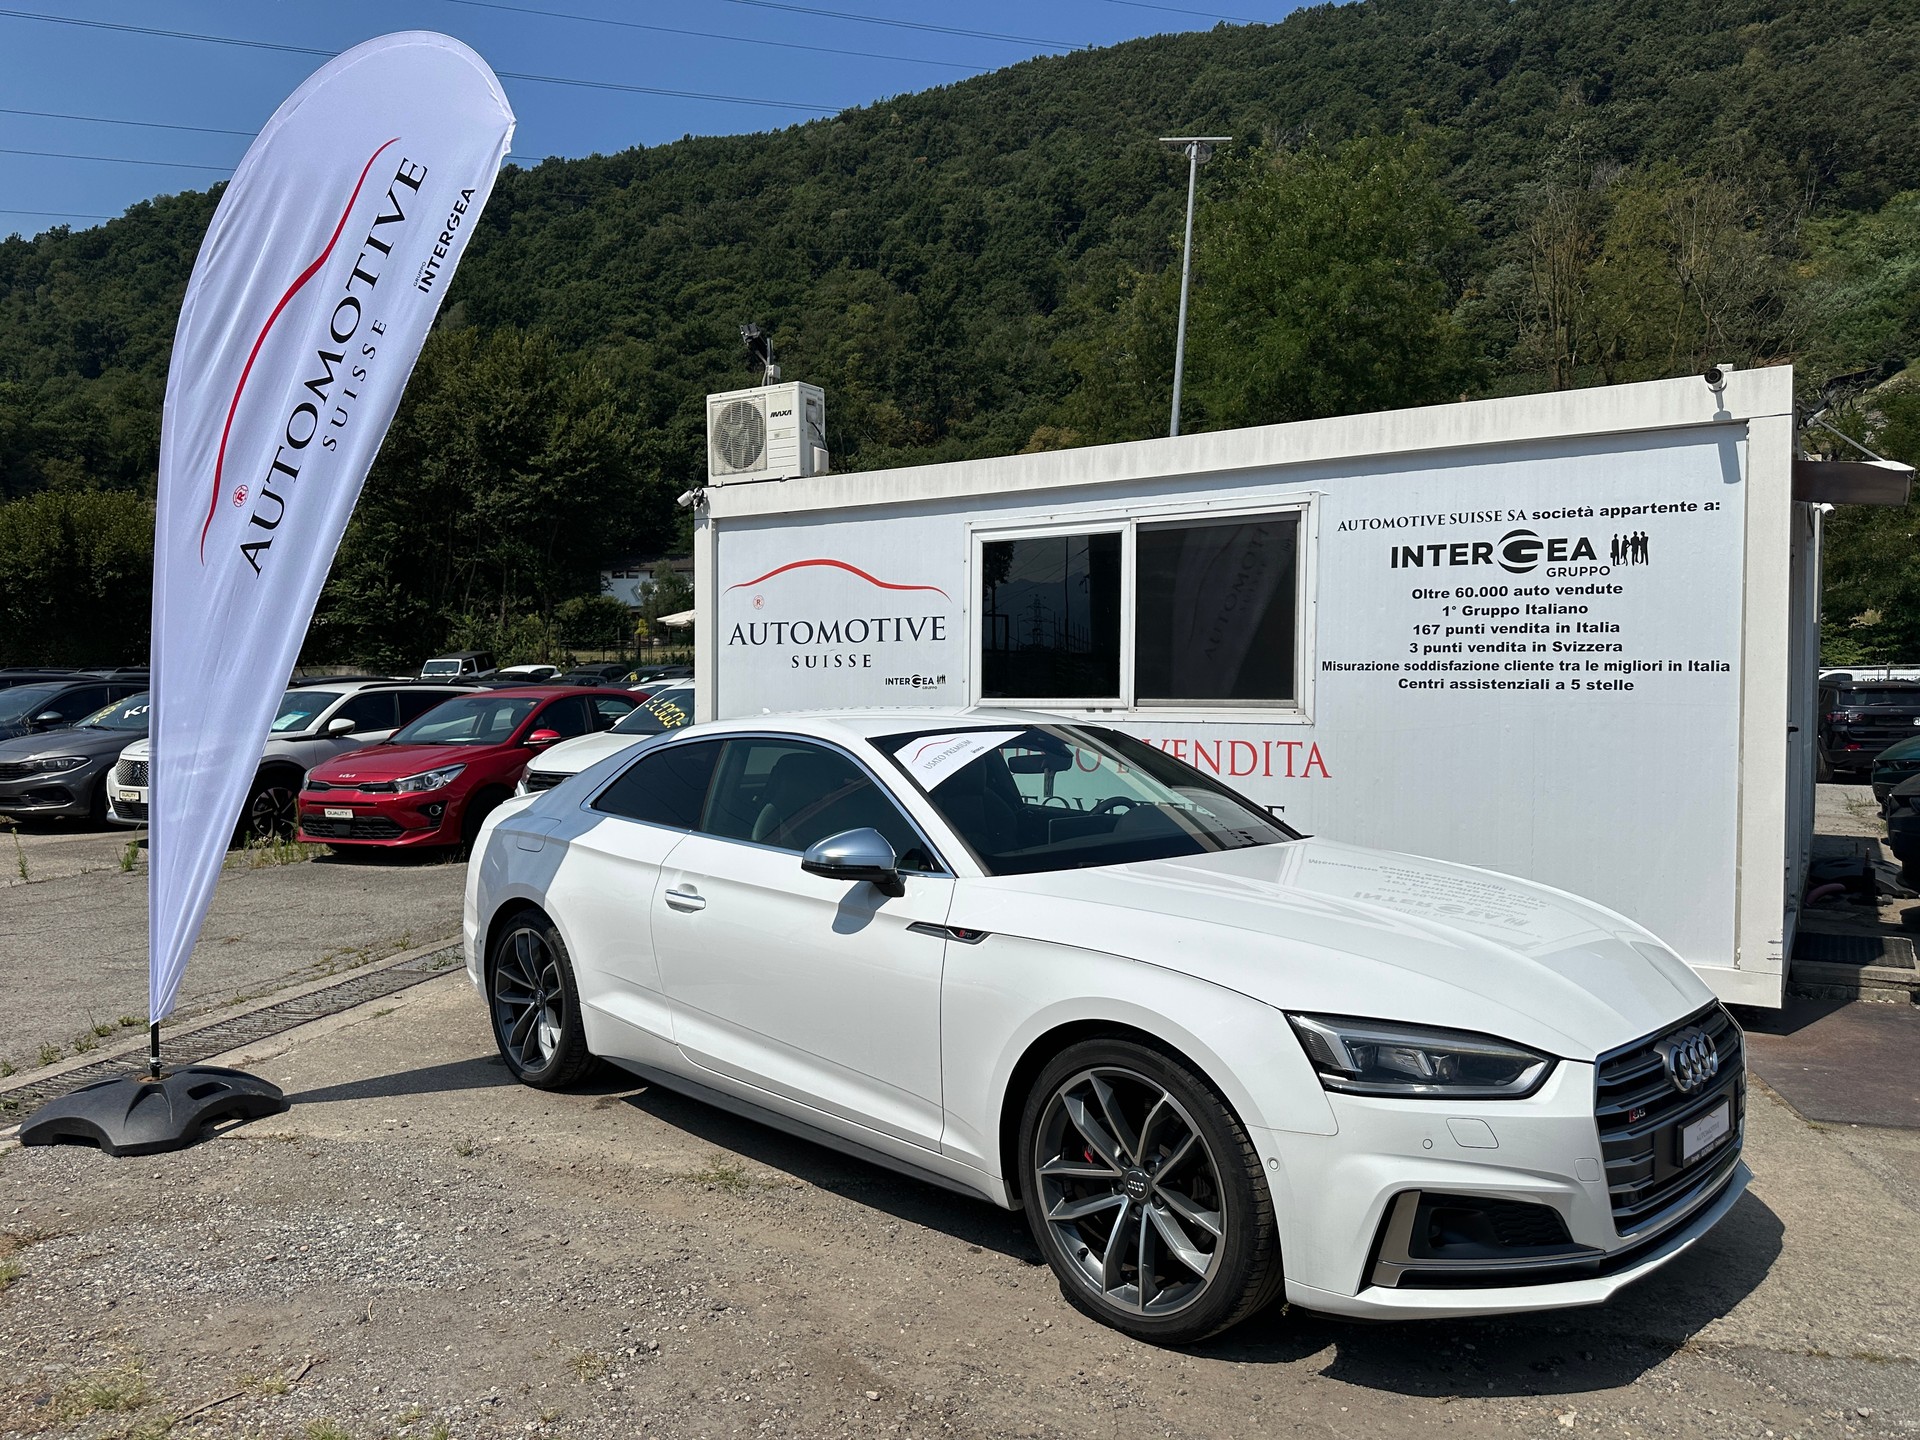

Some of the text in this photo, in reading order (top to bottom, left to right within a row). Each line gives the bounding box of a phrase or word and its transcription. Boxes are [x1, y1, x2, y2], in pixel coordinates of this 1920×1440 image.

[417, 189, 476, 294] INTERGEA
[240, 157, 428, 578] AUTOMOTIVE
[322, 319, 387, 452] SUISSE
[1337, 500, 1720, 532] AUTOMOTIVE SUISSE SA società appartente a:
[1390, 528, 1598, 574] INTERGEA
[1546, 565, 1611, 578] GRUPPO
[1411, 583, 1624, 600] Oltre 60.000 auto vendute
[1461, 605, 1520, 619] Gruppo
[1525, 603, 1589, 615] Italiano
[727, 615, 948, 646] AUTOMOTIVE
[1412, 621, 1620, 638] 167 punti vendita in Italia
[1409, 640, 1623, 656] 3 punti vendita in Svizzera
[791, 653, 872, 668] SUISSE
[1321, 659, 1731, 675] Misurazione soddisfazione cliente tra le migliori in Italia
[884, 674, 935, 688] INTERGEA
[1398, 678, 1635, 691] Centri assistenziali a 5 stelle
